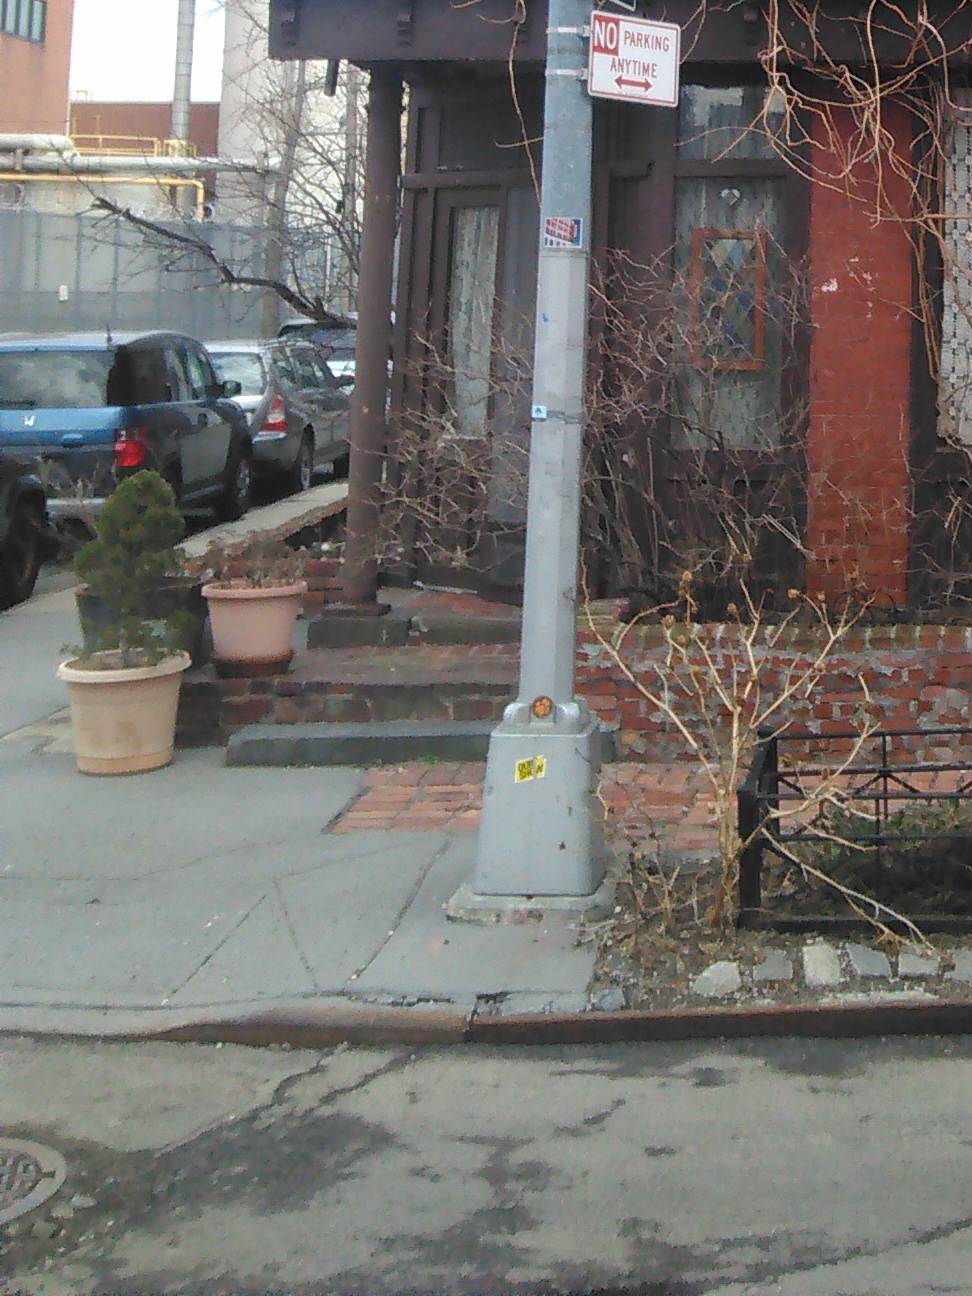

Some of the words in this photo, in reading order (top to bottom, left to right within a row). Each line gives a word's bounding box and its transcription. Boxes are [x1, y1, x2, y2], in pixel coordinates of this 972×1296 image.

[593, 19, 618, 50] NO
[623, 30, 670, 53] PARKING
[609, 57, 658, 79] ANYTIME
